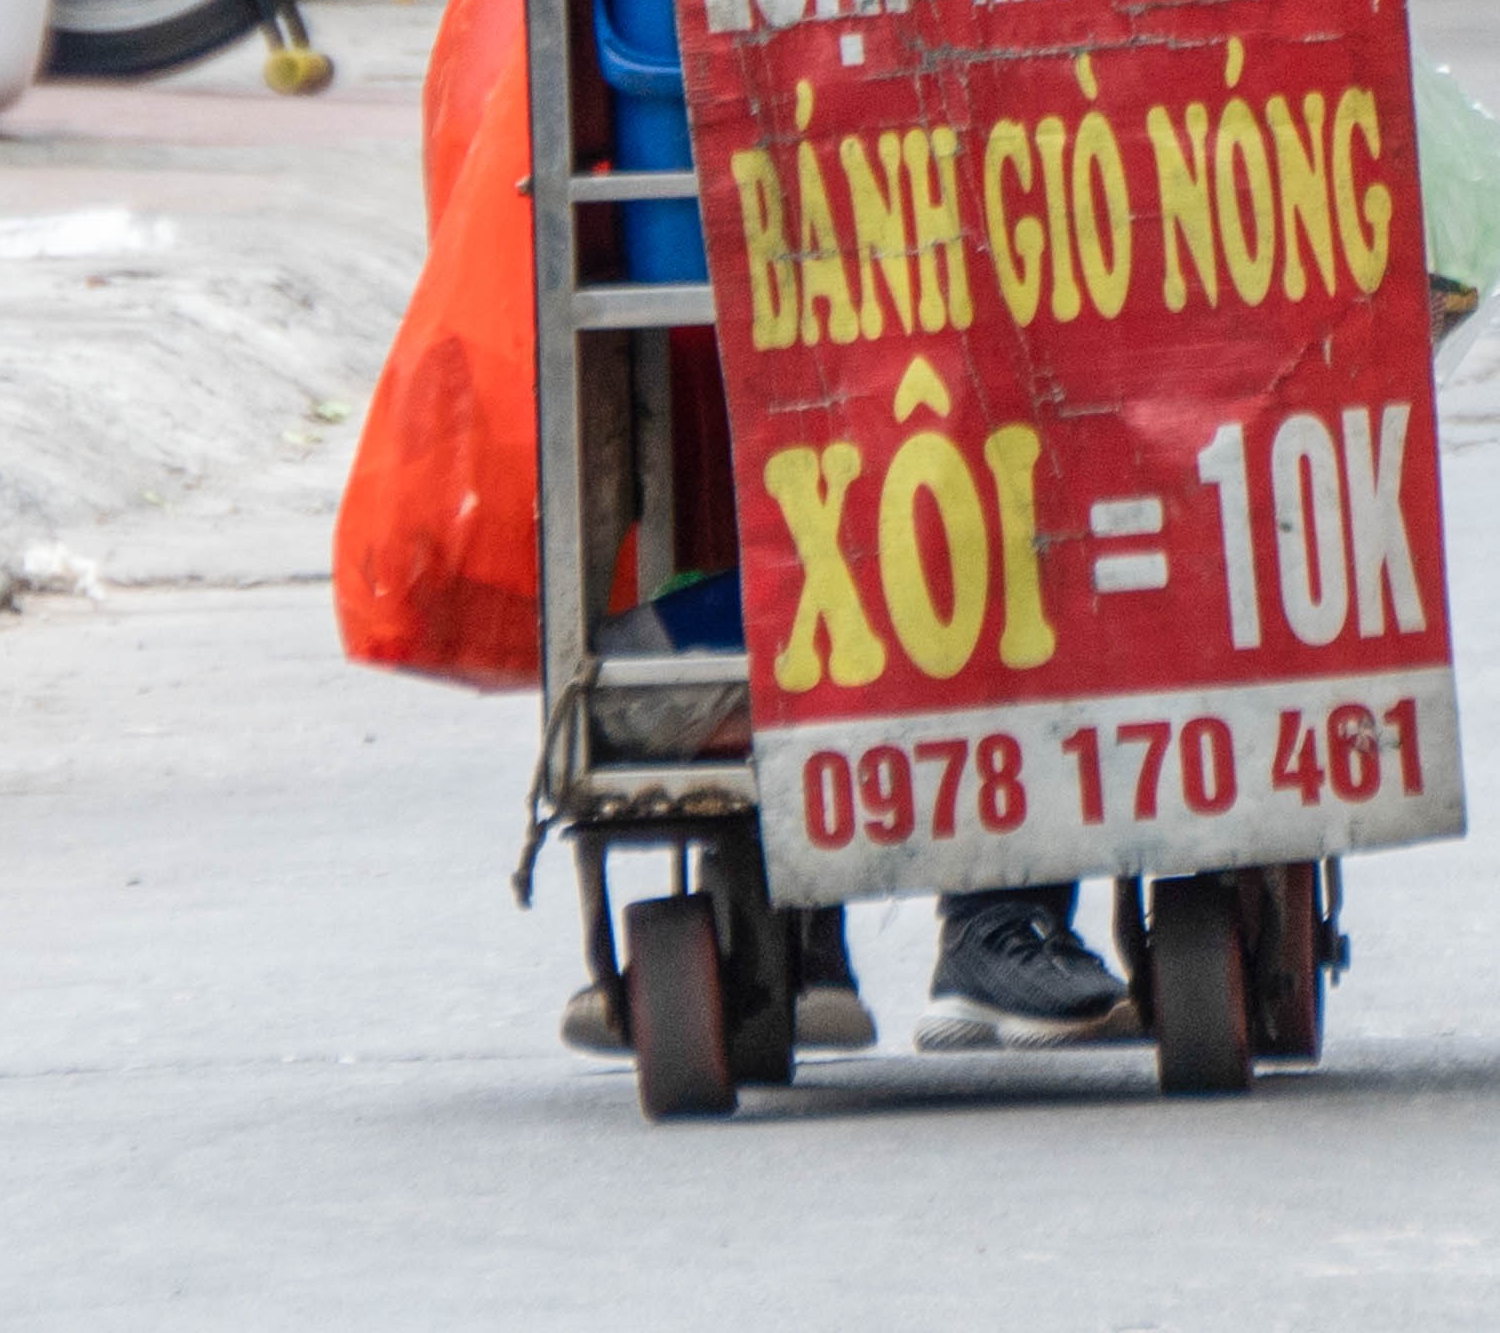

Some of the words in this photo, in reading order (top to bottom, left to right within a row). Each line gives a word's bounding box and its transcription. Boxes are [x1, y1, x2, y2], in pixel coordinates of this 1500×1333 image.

[730, 80, 974, 352] BÁNH
[984, 55, 1132, 328] GIÒ
[1148, 37, 1392, 316] NÓNG
[765, 357, 1058, 693] XÔI
[1198, 402, 1427, 652] 10K
[802, 732, 1027, 852] 0978
[1062, 717, 1238, 826] 170
[1270, 697, 1423, 806] 461
